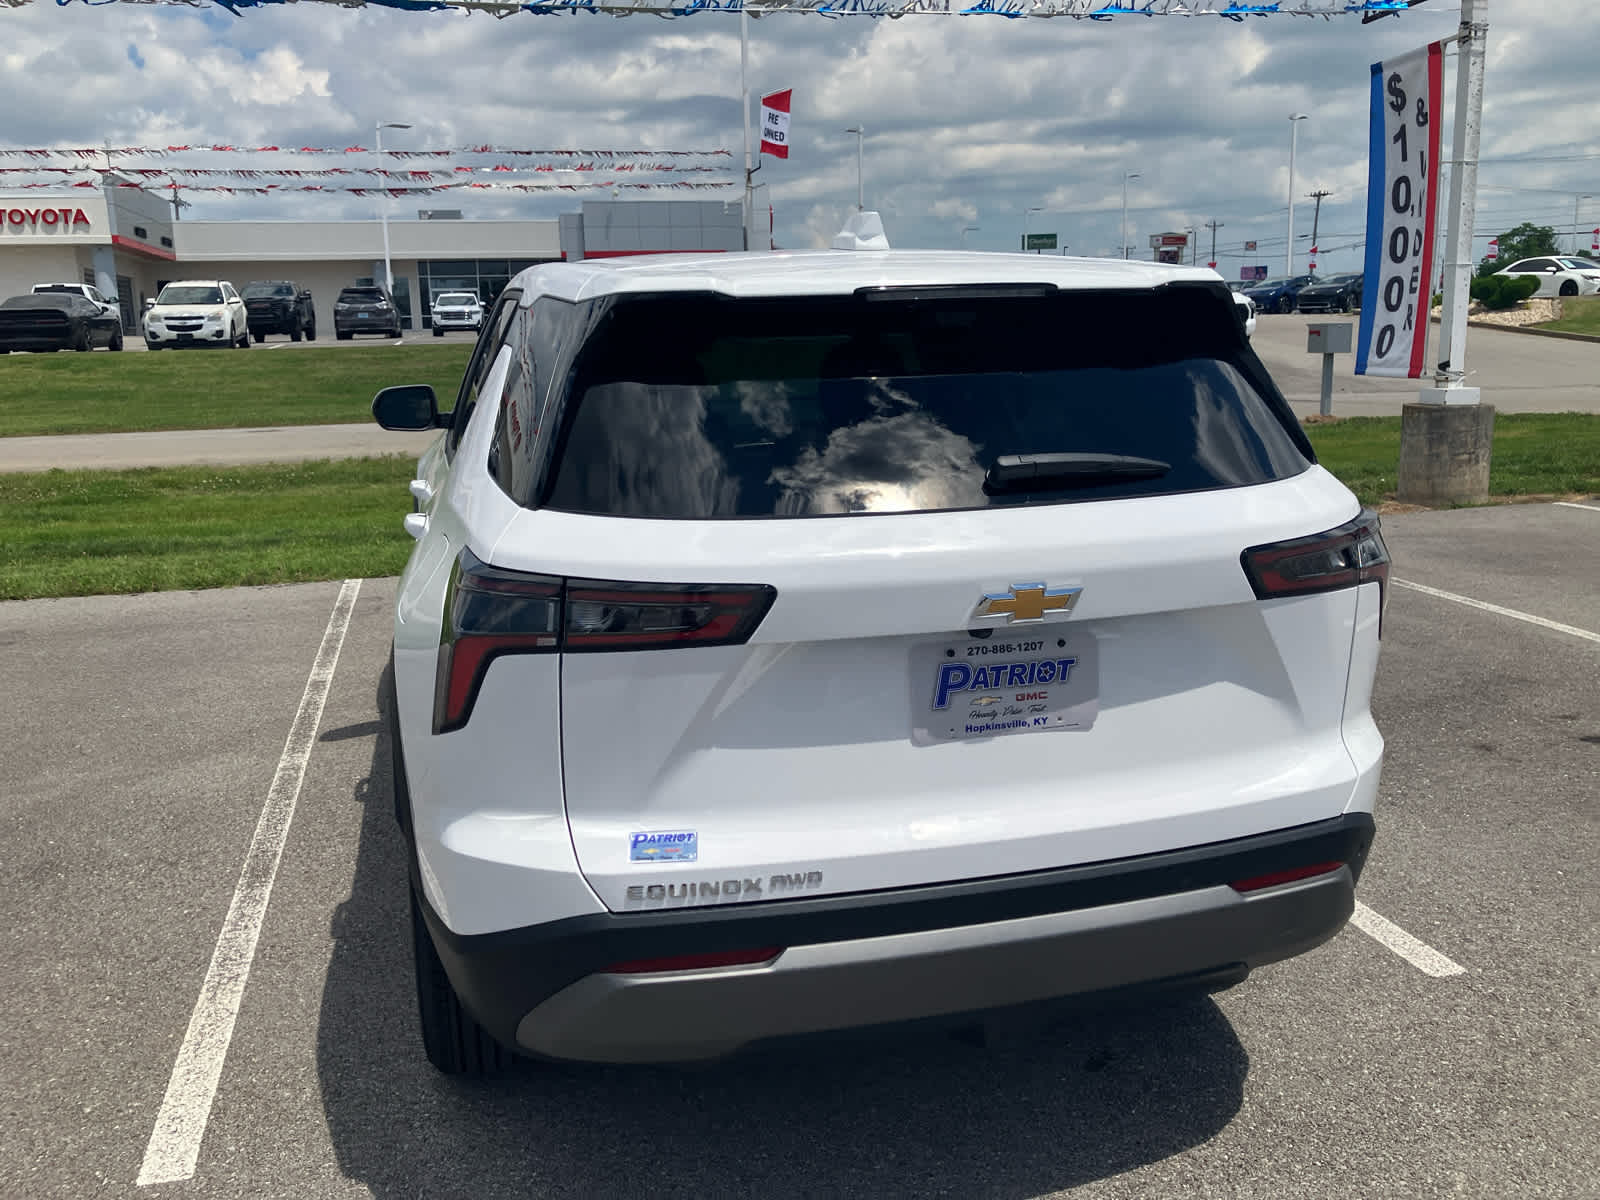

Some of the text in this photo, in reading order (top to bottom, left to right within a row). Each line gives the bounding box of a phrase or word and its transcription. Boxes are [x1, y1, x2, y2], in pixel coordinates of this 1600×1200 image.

[1416, 97, 1428, 127] &
[0, 208, 90, 225] TOYOTA
[1376, 72, 1414, 359] $10,000
[967, 641, 1044, 656] 270-886-1207
[933, 658, 1076, 710] PATRIOT
[1016, 691, 1048, 702] GMC
[965, 716, 1048, 733] Hopkinsville, KY
[632, 832, 695, 848] PATRIOT
[626, 871, 823, 901] EQUINOX AWD
